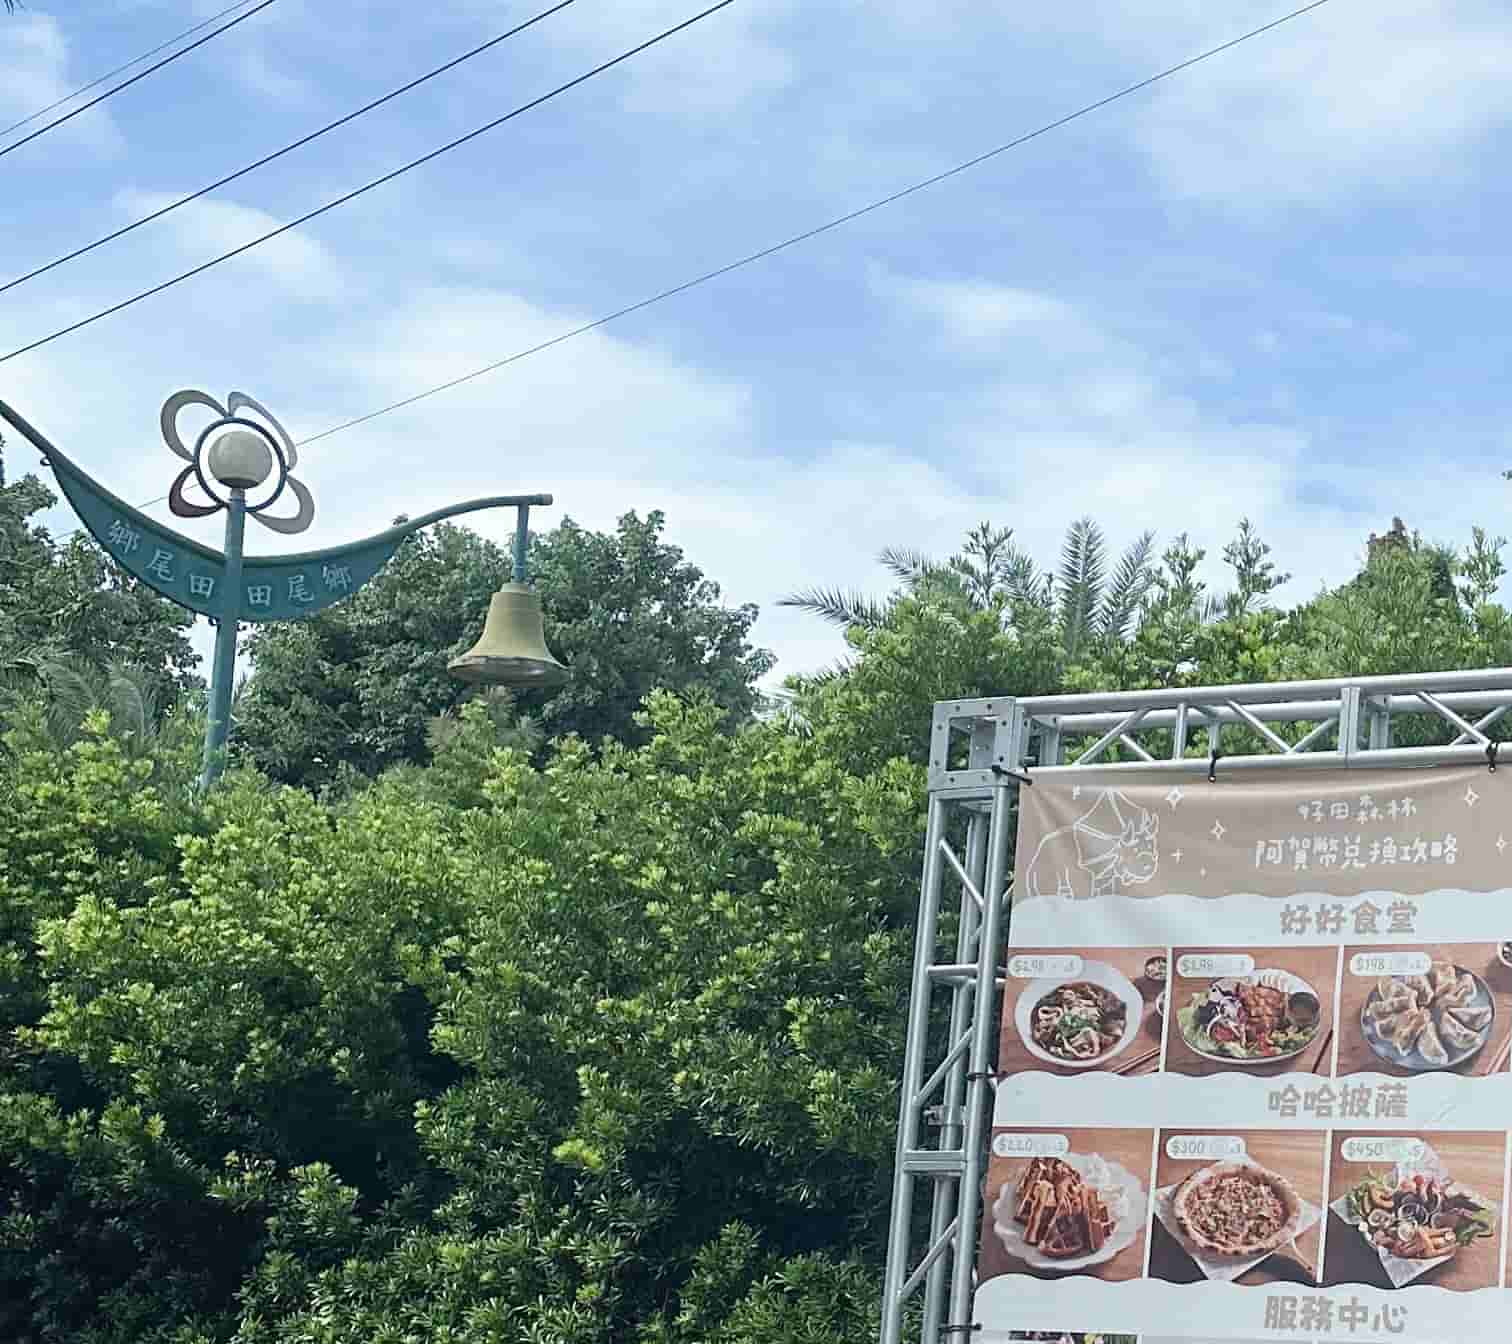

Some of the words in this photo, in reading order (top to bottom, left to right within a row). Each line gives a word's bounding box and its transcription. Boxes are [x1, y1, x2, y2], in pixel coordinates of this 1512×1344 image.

[247, 561, 353, 607] 田尾鄉
[1279, 900, 1419, 937] 好好食堂
[1269, 1083, 1409, 1118] 哈哈披薩
[1264, 1294, 1408, 1333] 服務中心
